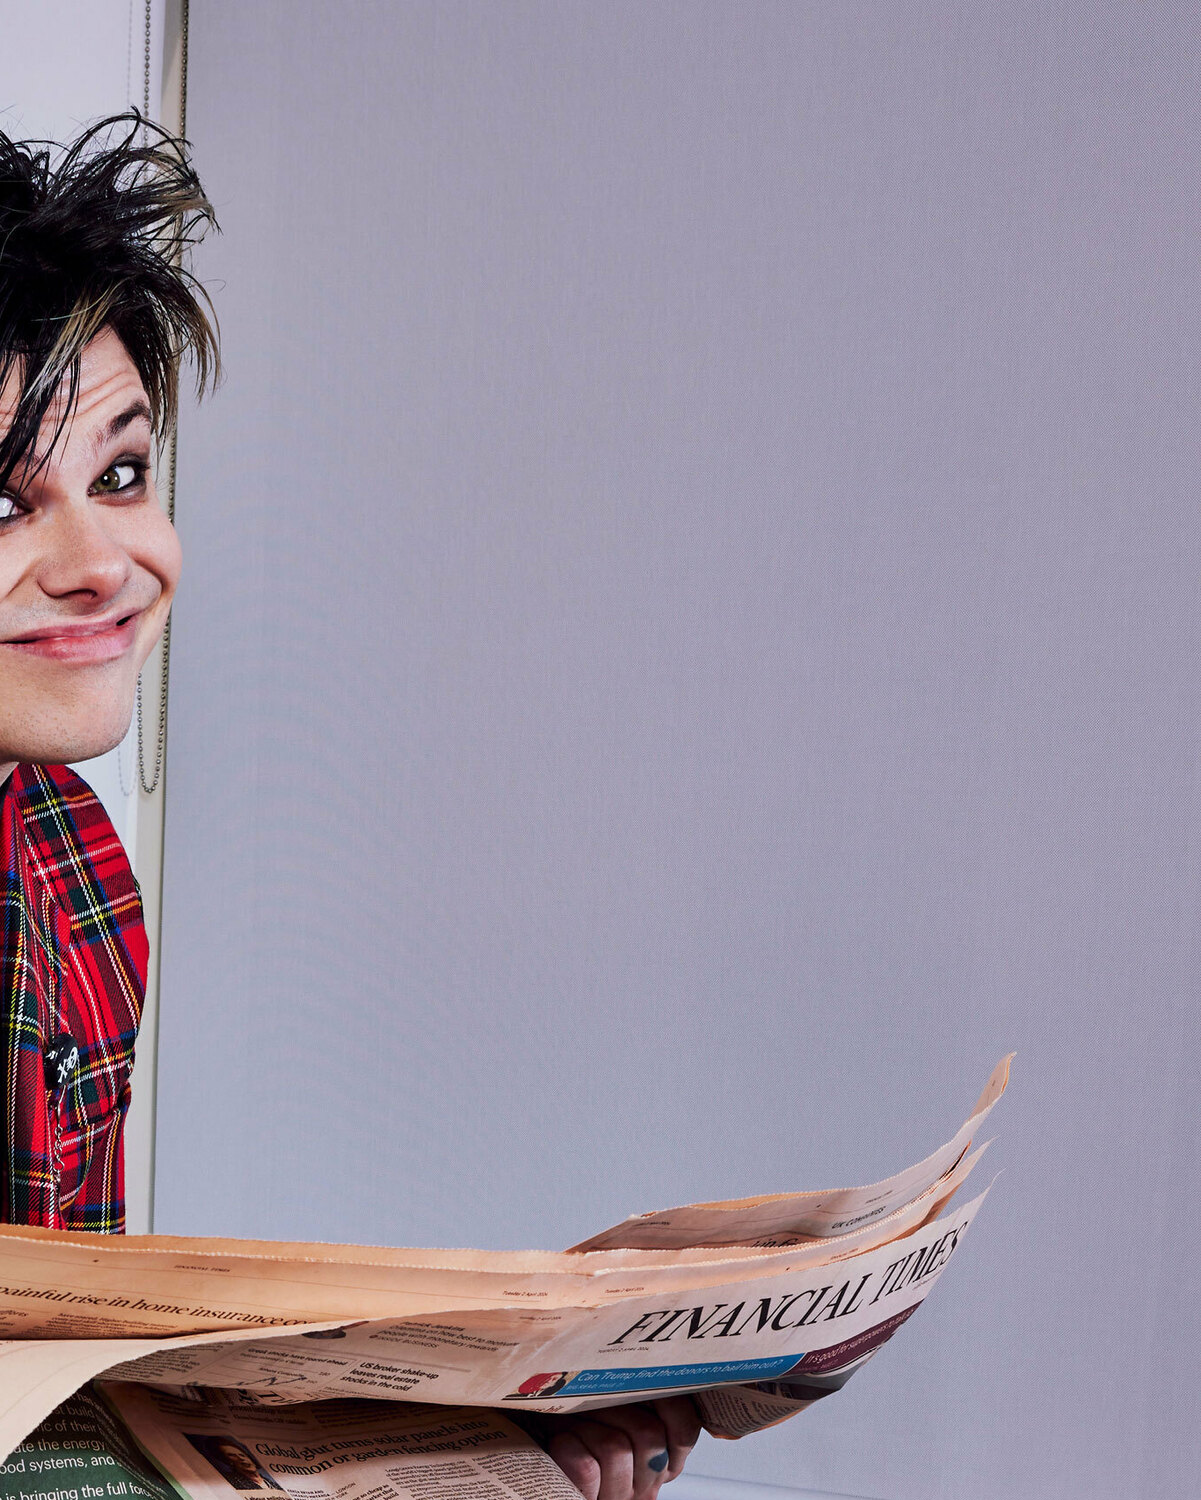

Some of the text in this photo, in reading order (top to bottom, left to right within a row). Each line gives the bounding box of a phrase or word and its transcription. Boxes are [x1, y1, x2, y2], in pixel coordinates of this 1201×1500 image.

[607, 1273, 873, 1346] FINANCIAL
[869, 1220, 969, 1305] TIMES
[67, 1294, 108, 1306] rise
[107, 1296, 131, 1307] in
[130, 1299, 190, 1316] home
[189, 1306, 286, 1325] insurance
[349, 1368, 378, 1378] leaves
[393, 1376, 421, 1385] estate
[372, 1363, 402, 1373] broker
[400, 1368, 440, 1380] shake-up
[578, 1359, 784, 1382] Can Trump find the donors to bail him out?
[340, 1376, 369, 1385] stocks
[377, 1381, 393, 1389] the
[54, 1419, 69, 1432] of
[38, 1438, 60, 1452] the
[62, 1439, 105, 1452] energy
[256, 1420, 488, 1462] Global glut turns solar panels into
[269, 1429, 508, 1476] common or garden fencing option
[29, 1457, 89, 1475] systems,
[91, 1454, 116, 1467] and
[81, 1484, 104, 1498] the
[106, 1481, 128, 1496] full
